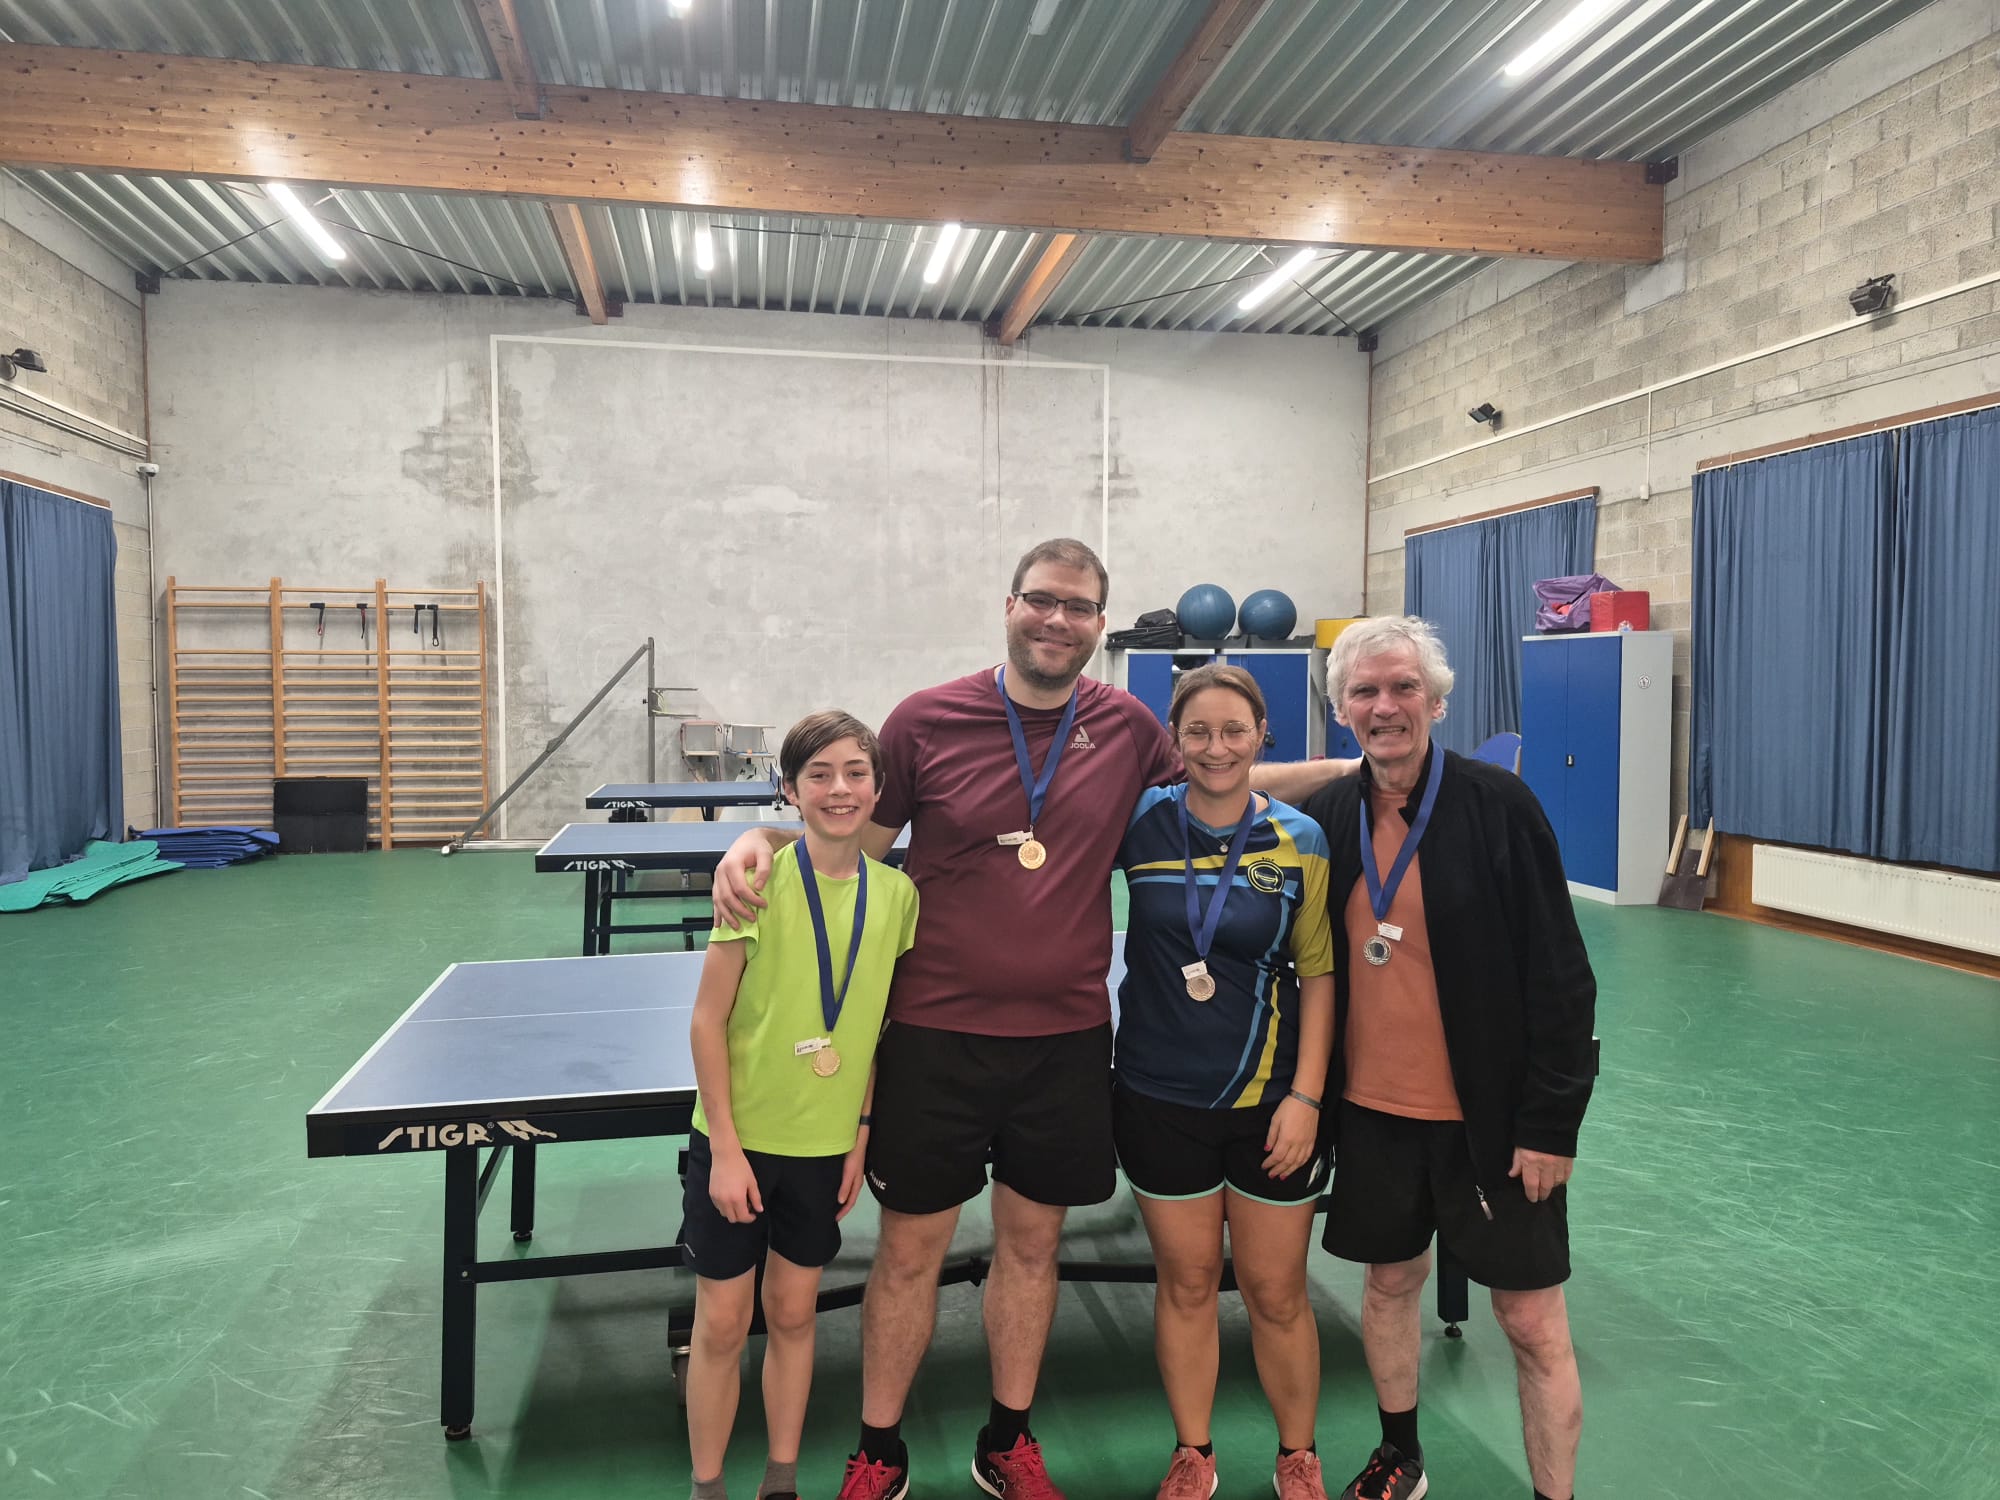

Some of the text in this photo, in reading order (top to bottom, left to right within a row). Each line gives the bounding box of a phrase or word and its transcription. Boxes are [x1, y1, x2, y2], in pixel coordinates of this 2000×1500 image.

[604, 800, 635, 808] STIGA
[564, 860, 610, 871] STIGA
[379, 1122, 494, 1150] STIGA
